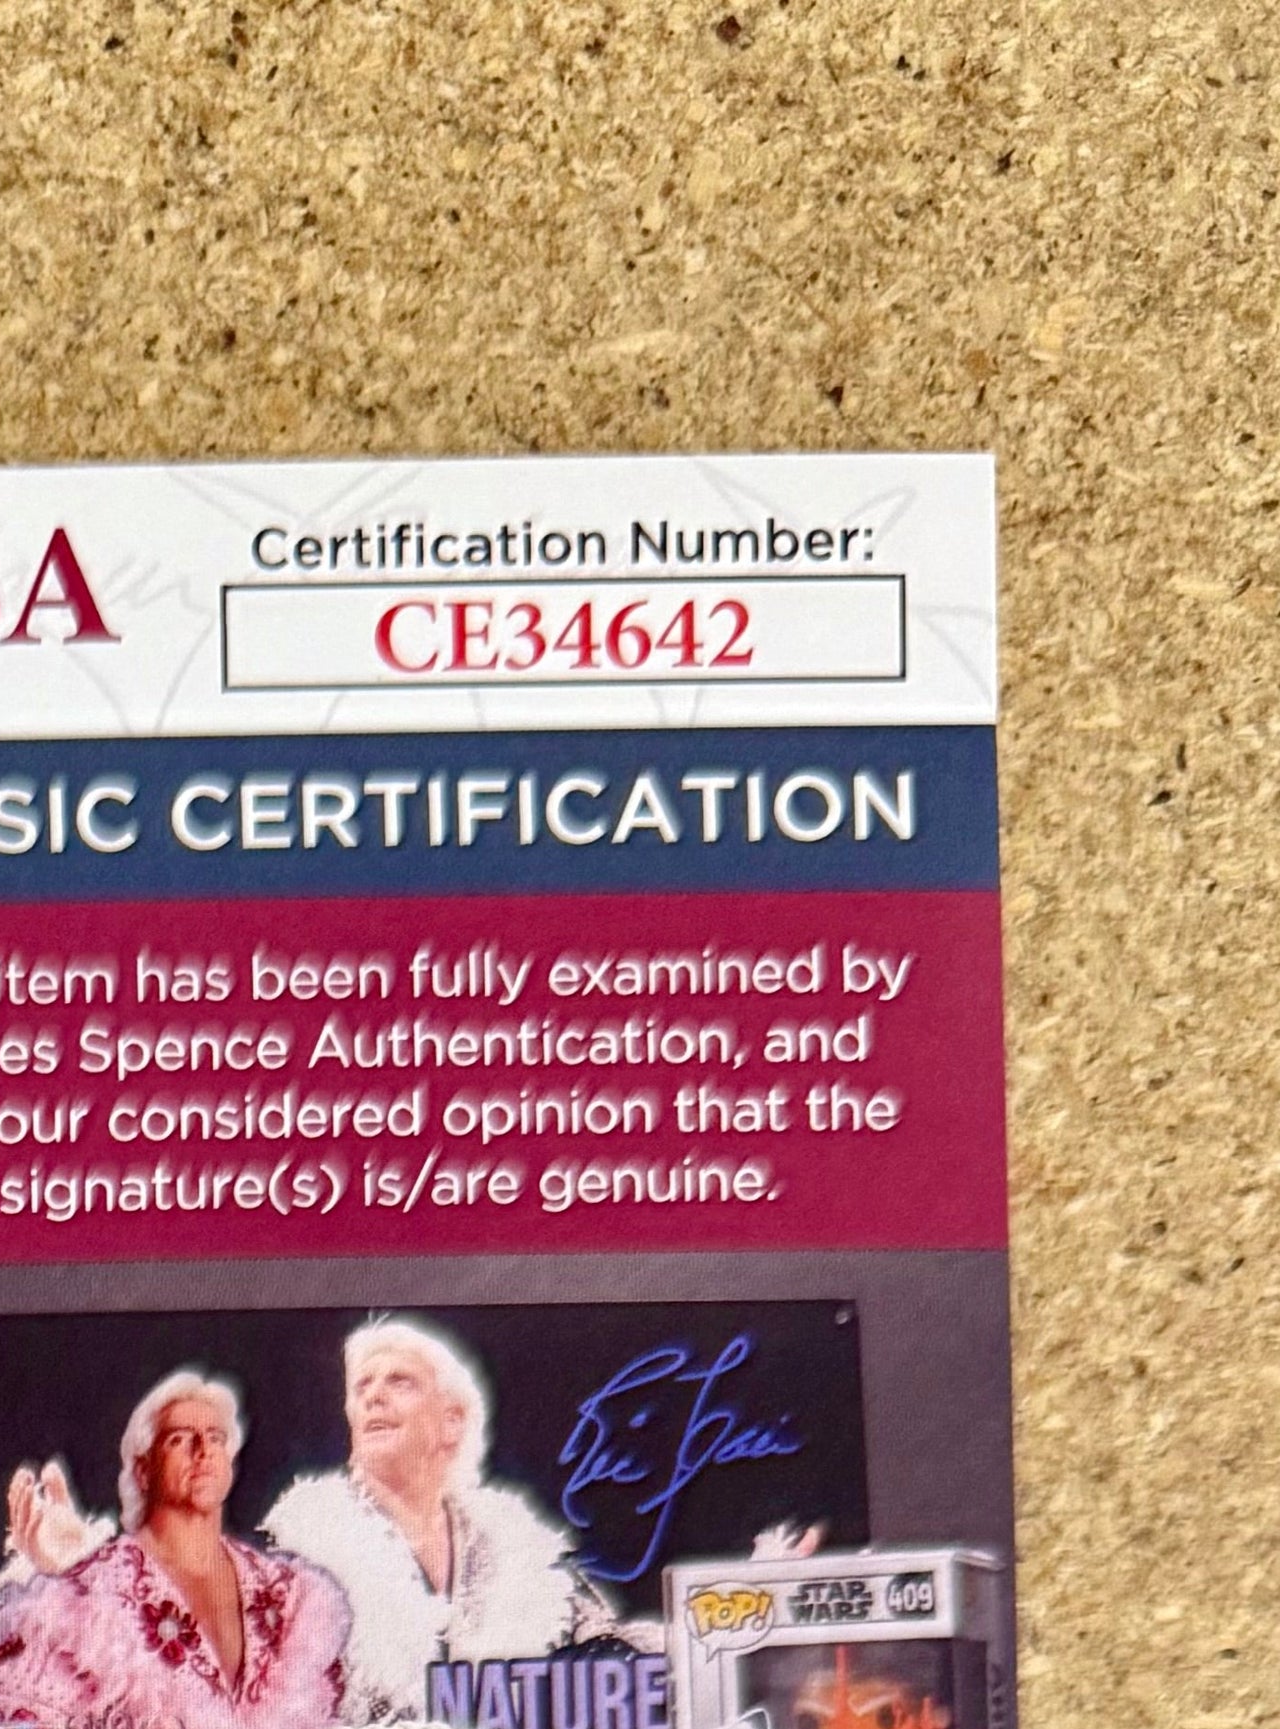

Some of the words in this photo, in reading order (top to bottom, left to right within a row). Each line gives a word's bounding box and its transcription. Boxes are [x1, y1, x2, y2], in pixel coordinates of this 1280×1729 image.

[252, 523, 606, 569] Certification
[631, 518, 873, 563] Number:
[374, 599, 754, 673] CE34642
[171, 770, 915, 851] CERTIFICATION
[136, 953, 231, 1003] has
[251, 951, 391, 1001] been
[408, 948, 532, 1006] fully
[548, 945, 823, 996] examined
[842, 944, 911, 1001] by
[79, 1024, 289, 1081] Spence
[308, 1018, 746, 1070] Authentication,
[763, 1014, 870, 1063] and
[108, 1087, 424, 1142] considered
[442, 1087, 656, 1144] opinion
[673, 1085, 788, 1133] that
[804, 1083, 898, 1132] the
[0, 1160, 344, 1222] signature(s)
[363, 1150, 522, 1213] is/are
[539, 1155, 779, 1212] genuine.
[688, 1588, 774, 1637] POP!
[790, 1580, 874, 1601] STAR
[792, 1601, 874, 1624] WARS
[886, 1579, 936, 1615] 409
